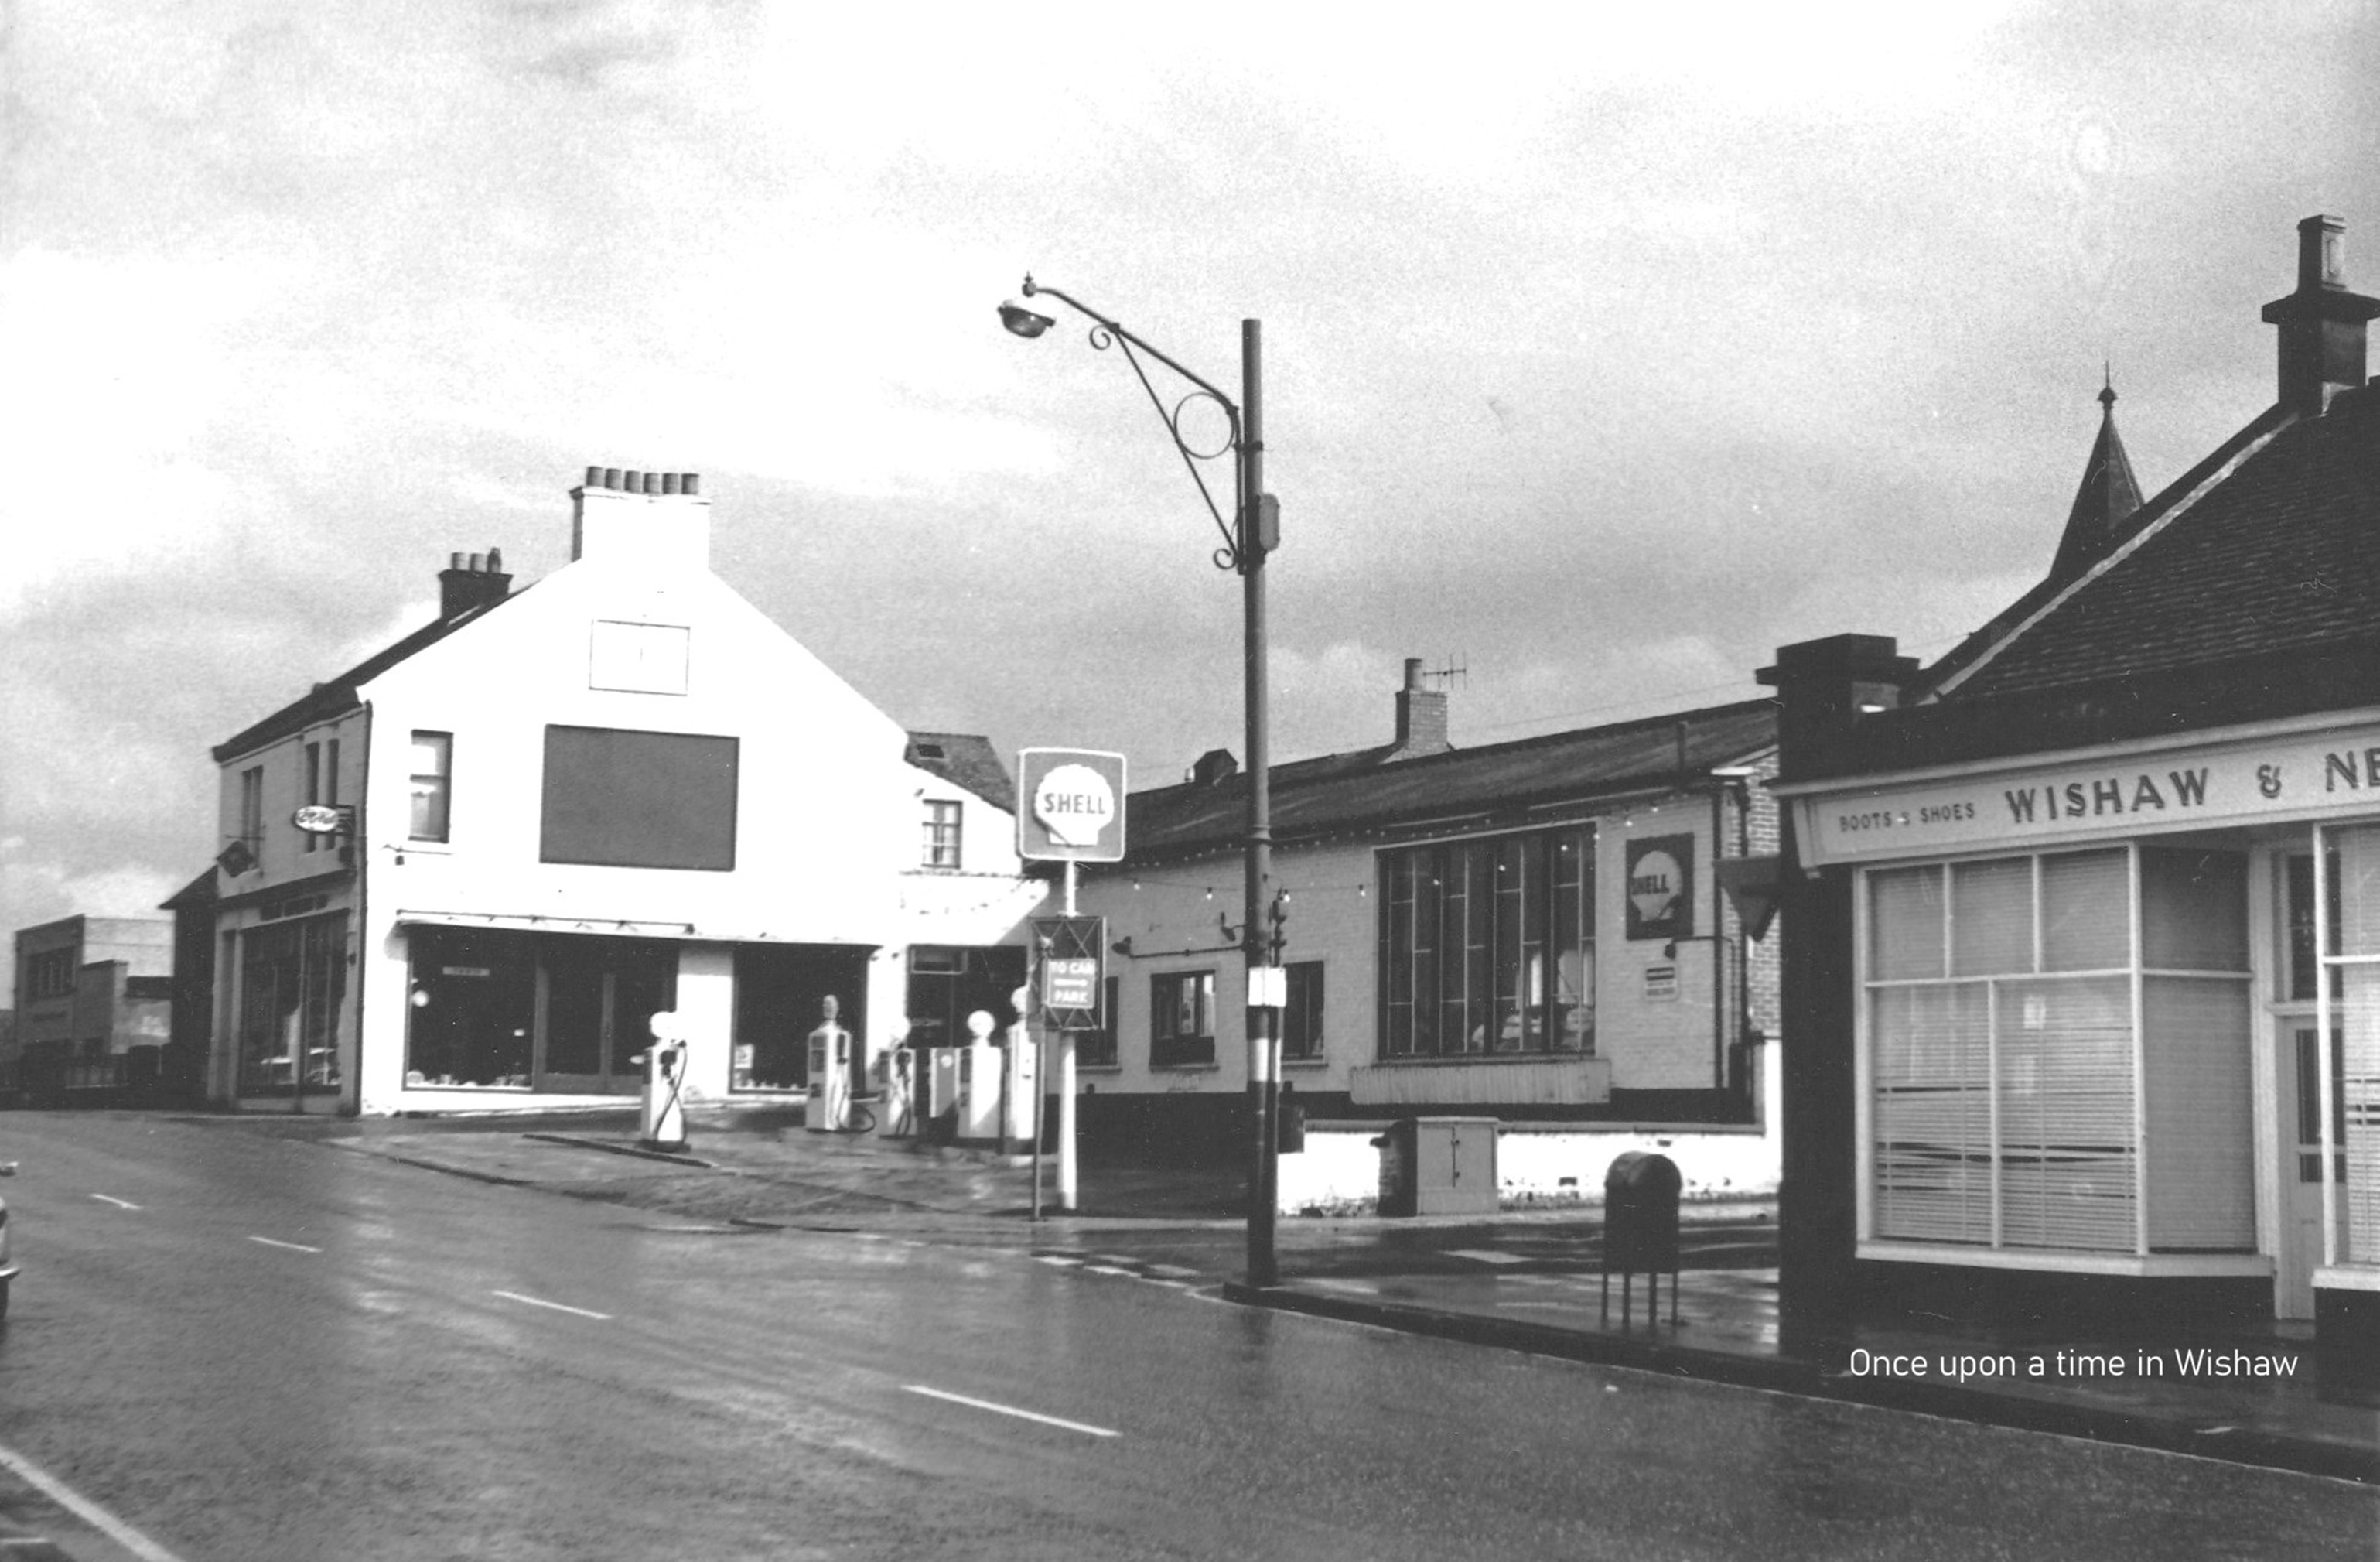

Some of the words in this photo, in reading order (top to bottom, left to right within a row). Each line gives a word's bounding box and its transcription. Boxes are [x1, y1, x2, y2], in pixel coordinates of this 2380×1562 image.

[1043, 792, 1107, 815] SHELL
[2005, 767, 2209, 824] WISHAW
[2255, 764, 2283, 799] &
[1839, 811, 1893, 832] BOOTS
[1920, 802, 1975, 823] SHOES
[1050, 961, 1067, 974] TO
[1054, 989, 1088, 1003] PARK
